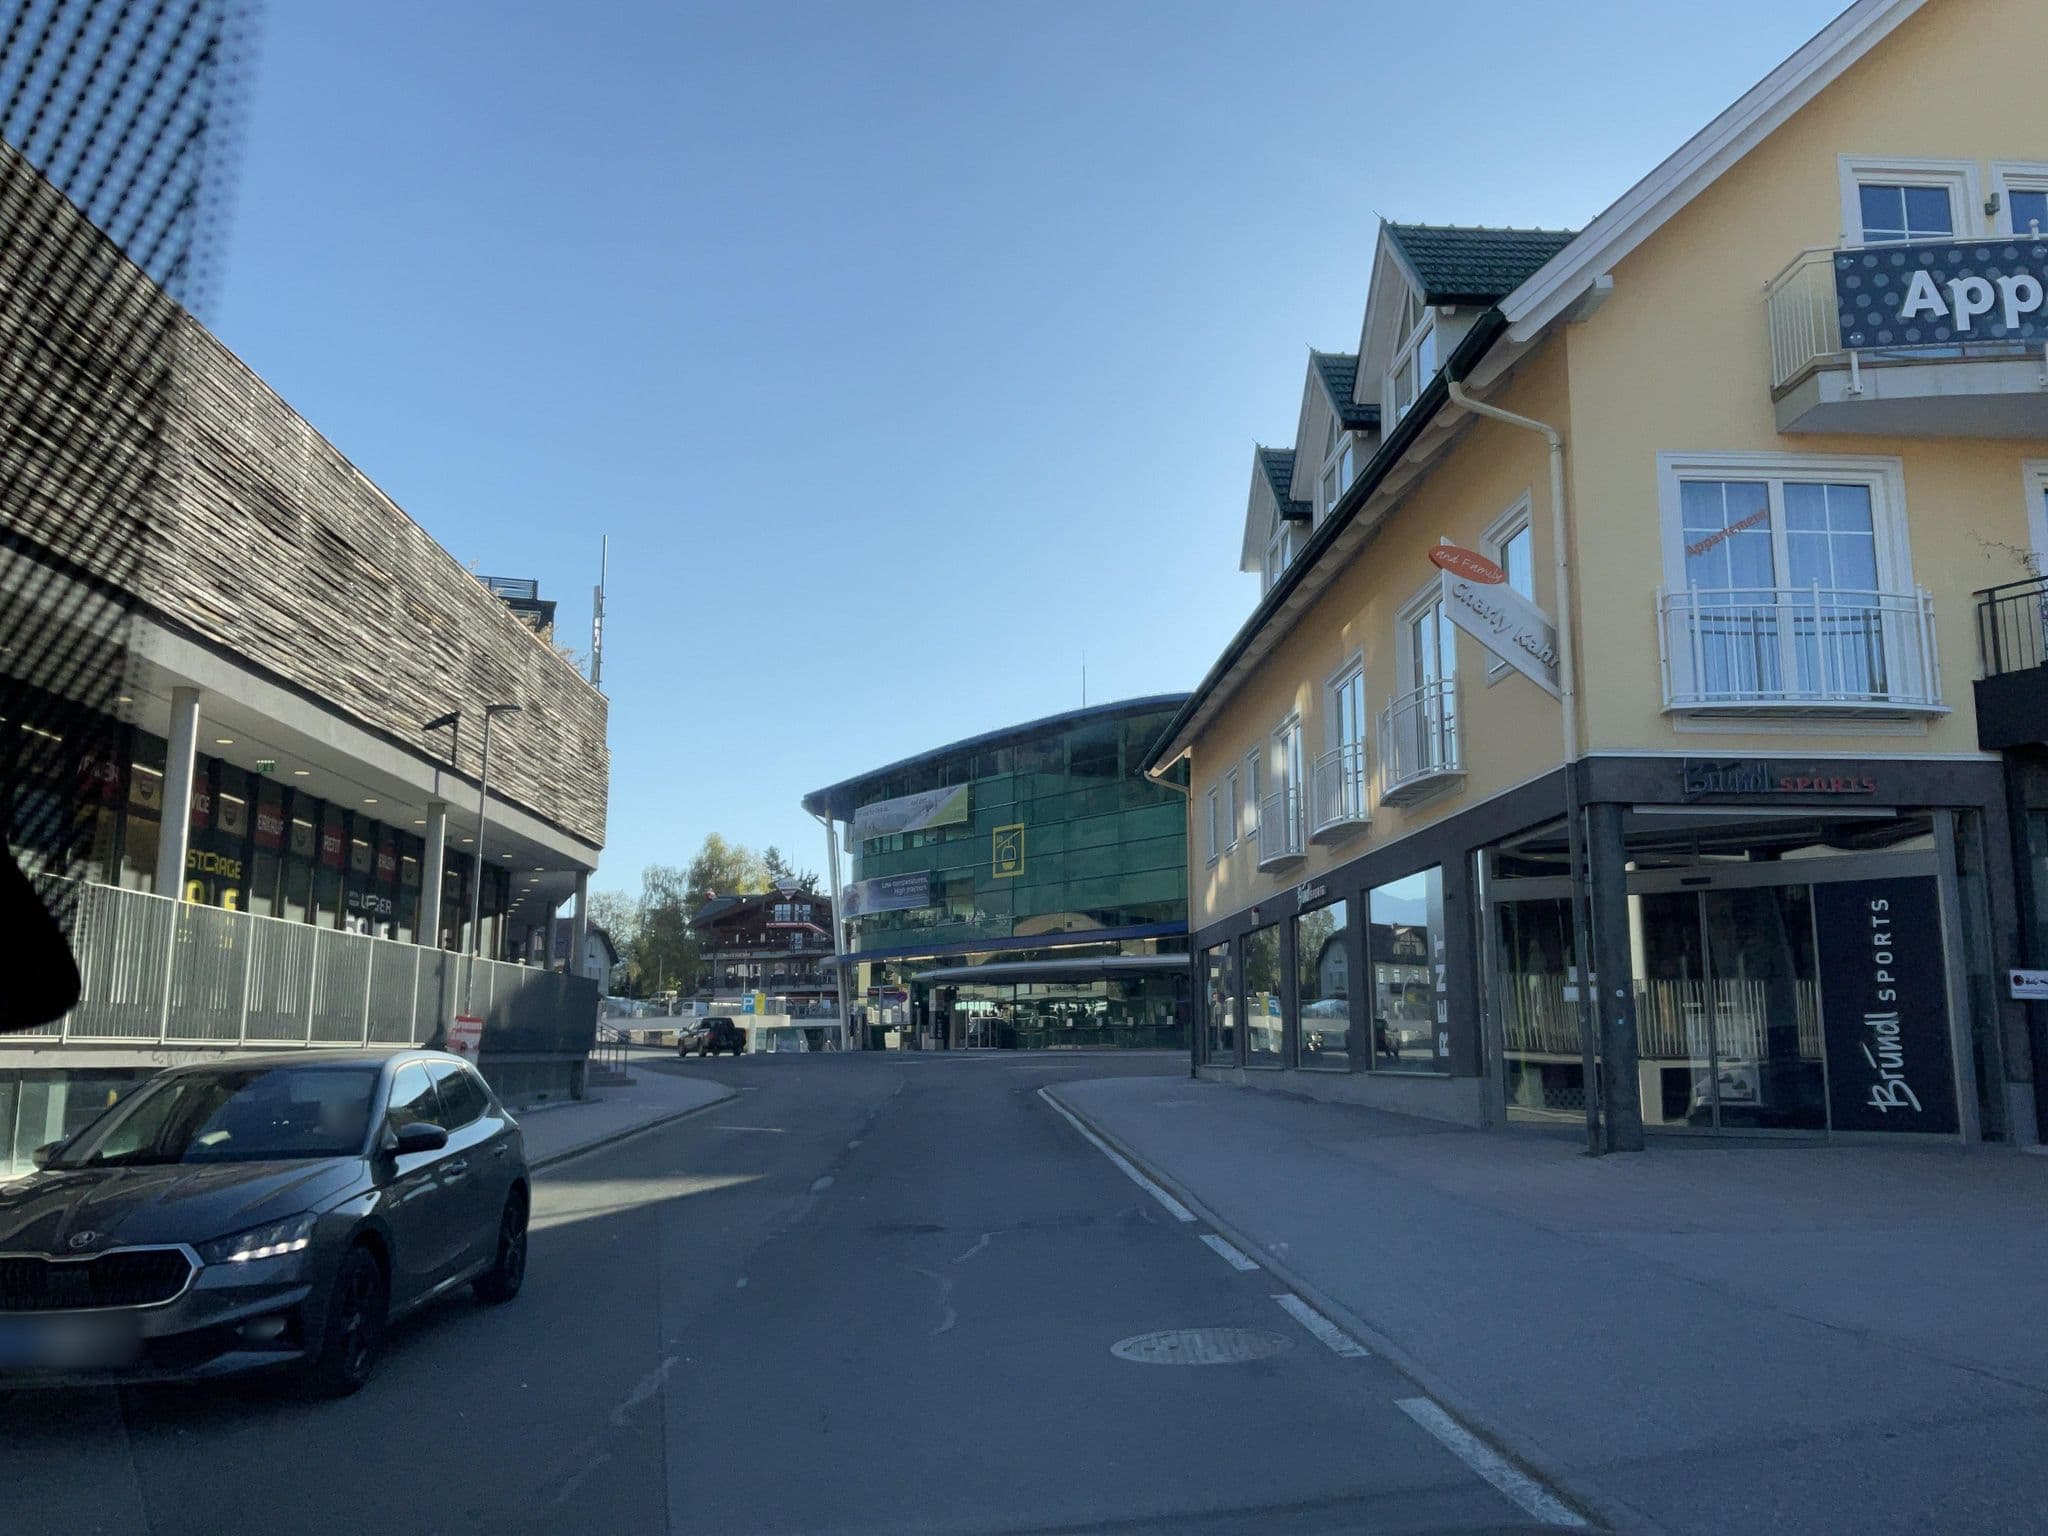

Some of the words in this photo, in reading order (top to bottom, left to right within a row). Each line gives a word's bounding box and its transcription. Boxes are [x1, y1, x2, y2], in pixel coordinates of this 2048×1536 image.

[1901, 270, 2044, 331] App
[1435, 550, 1457, 564] and
[1461, 558, 1503, 583] Family
[1779, 776, 1878, 793] SPORTS
[187, 848, 242, 880] STORAGE
[1871, 898, 1898, 1002] SPORTS
[743, 997, 754, 1011] P
[1434, 934, 1450, 1057] RENT
